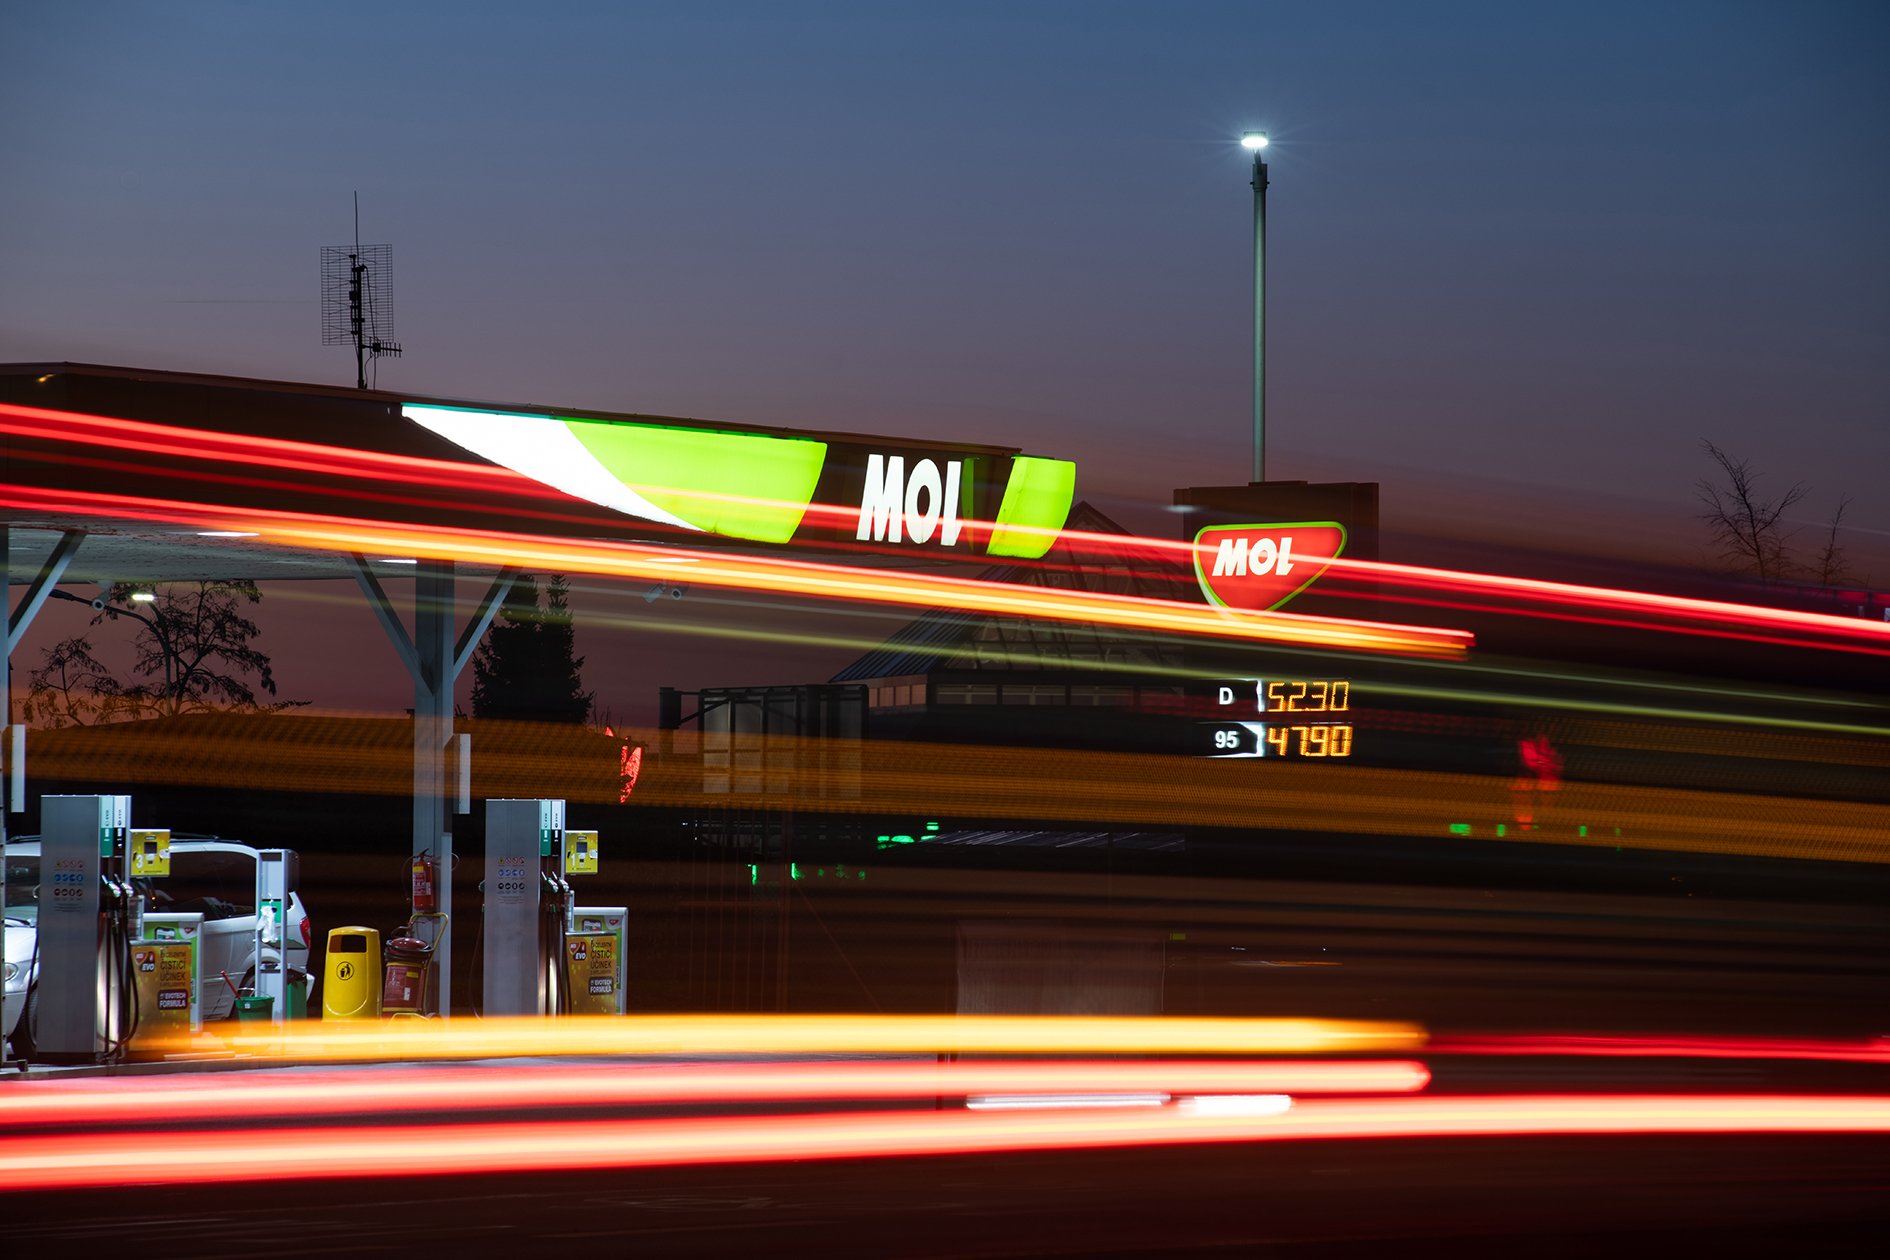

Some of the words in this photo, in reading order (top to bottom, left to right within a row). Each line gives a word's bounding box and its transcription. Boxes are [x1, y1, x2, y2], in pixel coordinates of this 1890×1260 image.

[856, 454, 963, 546] MOL
[1212, 537, 1294, 577] MOL
[1219, 687, 1234, 704] D
[1215, 731, 1237, 748] 95
[136, 854, 144, 868] 3
